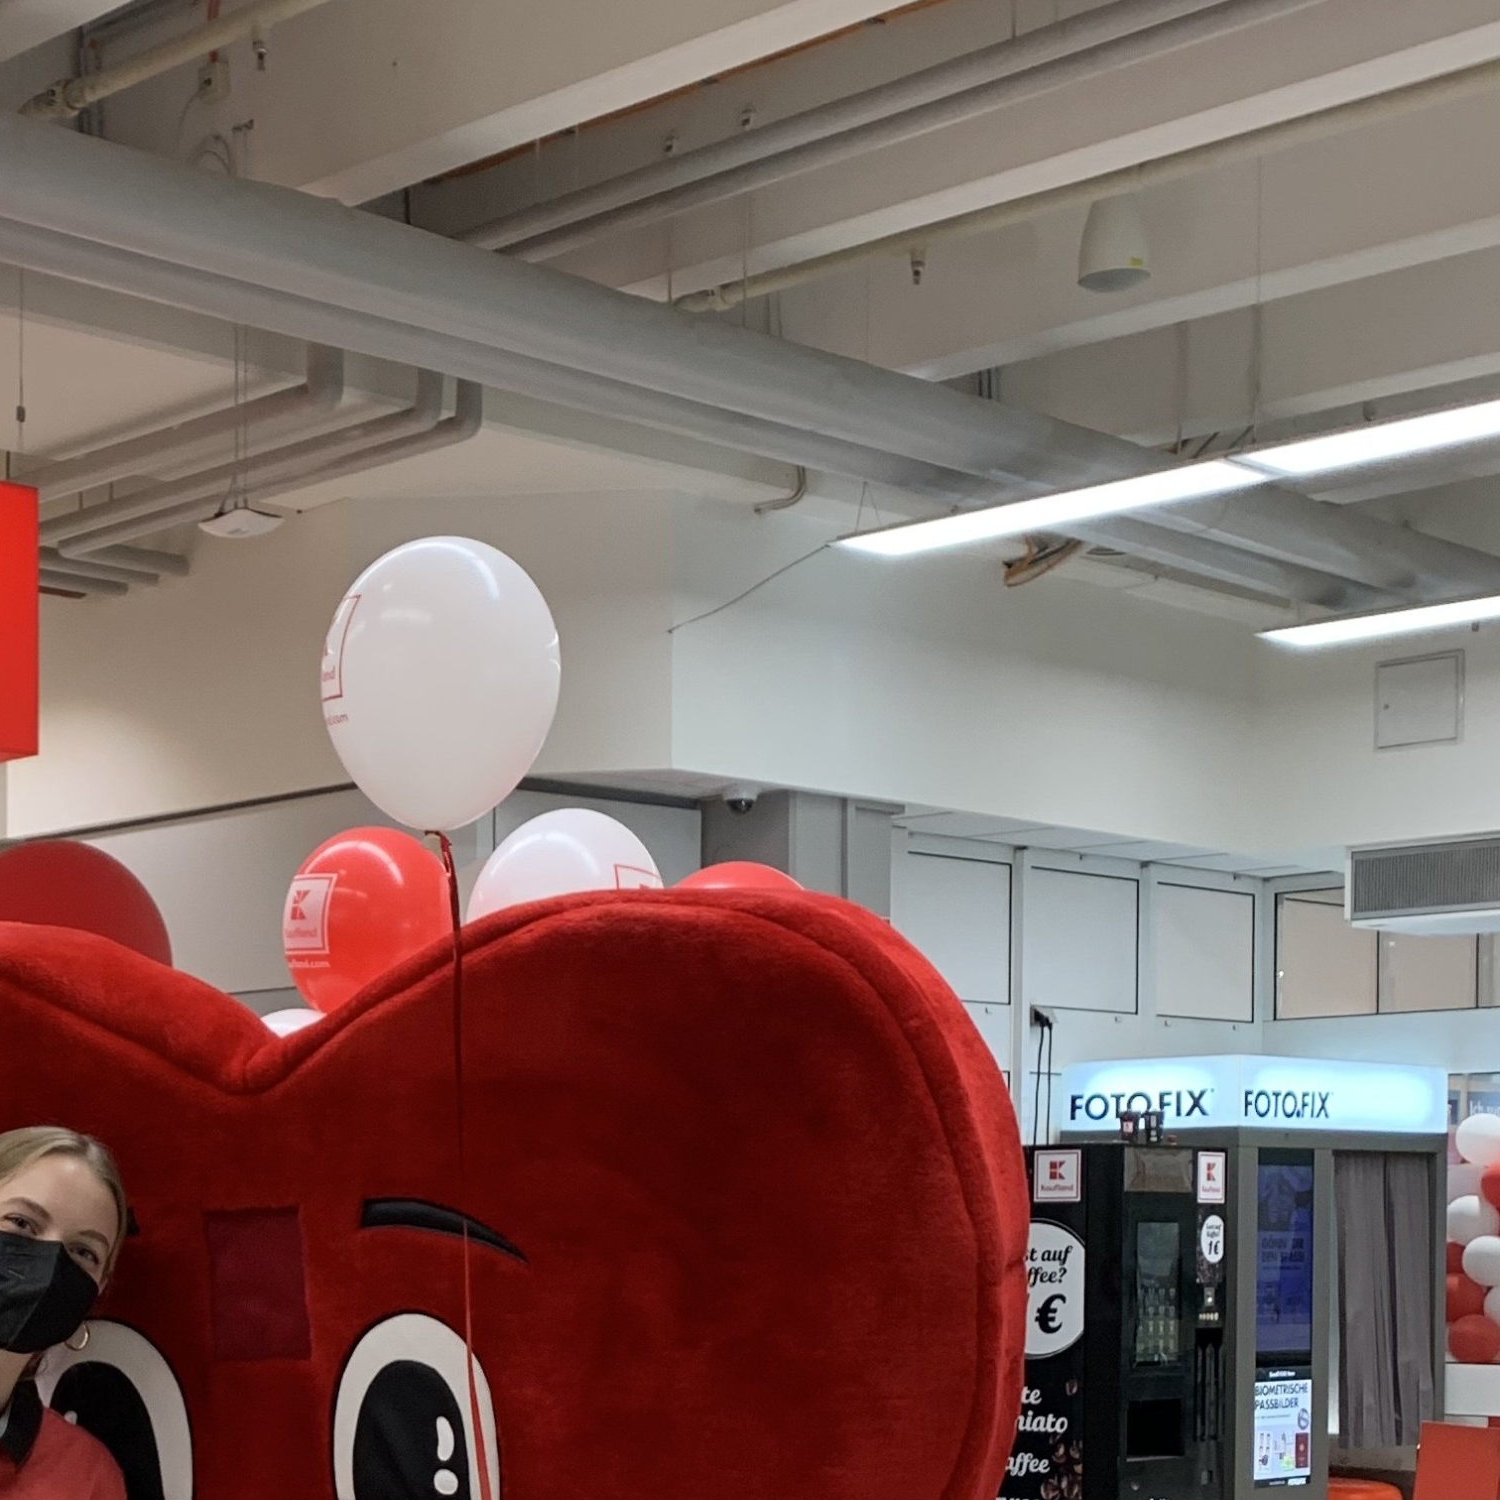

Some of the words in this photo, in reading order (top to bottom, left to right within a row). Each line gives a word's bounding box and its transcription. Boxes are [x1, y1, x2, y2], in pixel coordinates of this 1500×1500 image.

[1040, 1183, 1074, 1192] Kaufland
[1041, 1245, 1073, 1266] auf
[1027, 1267, 1067, 1287] ffee?
[1254, 1382, 1308, 1397] BIOMETRISCHE
[1255, 1397, 1299, 1410] PASSBILDER
